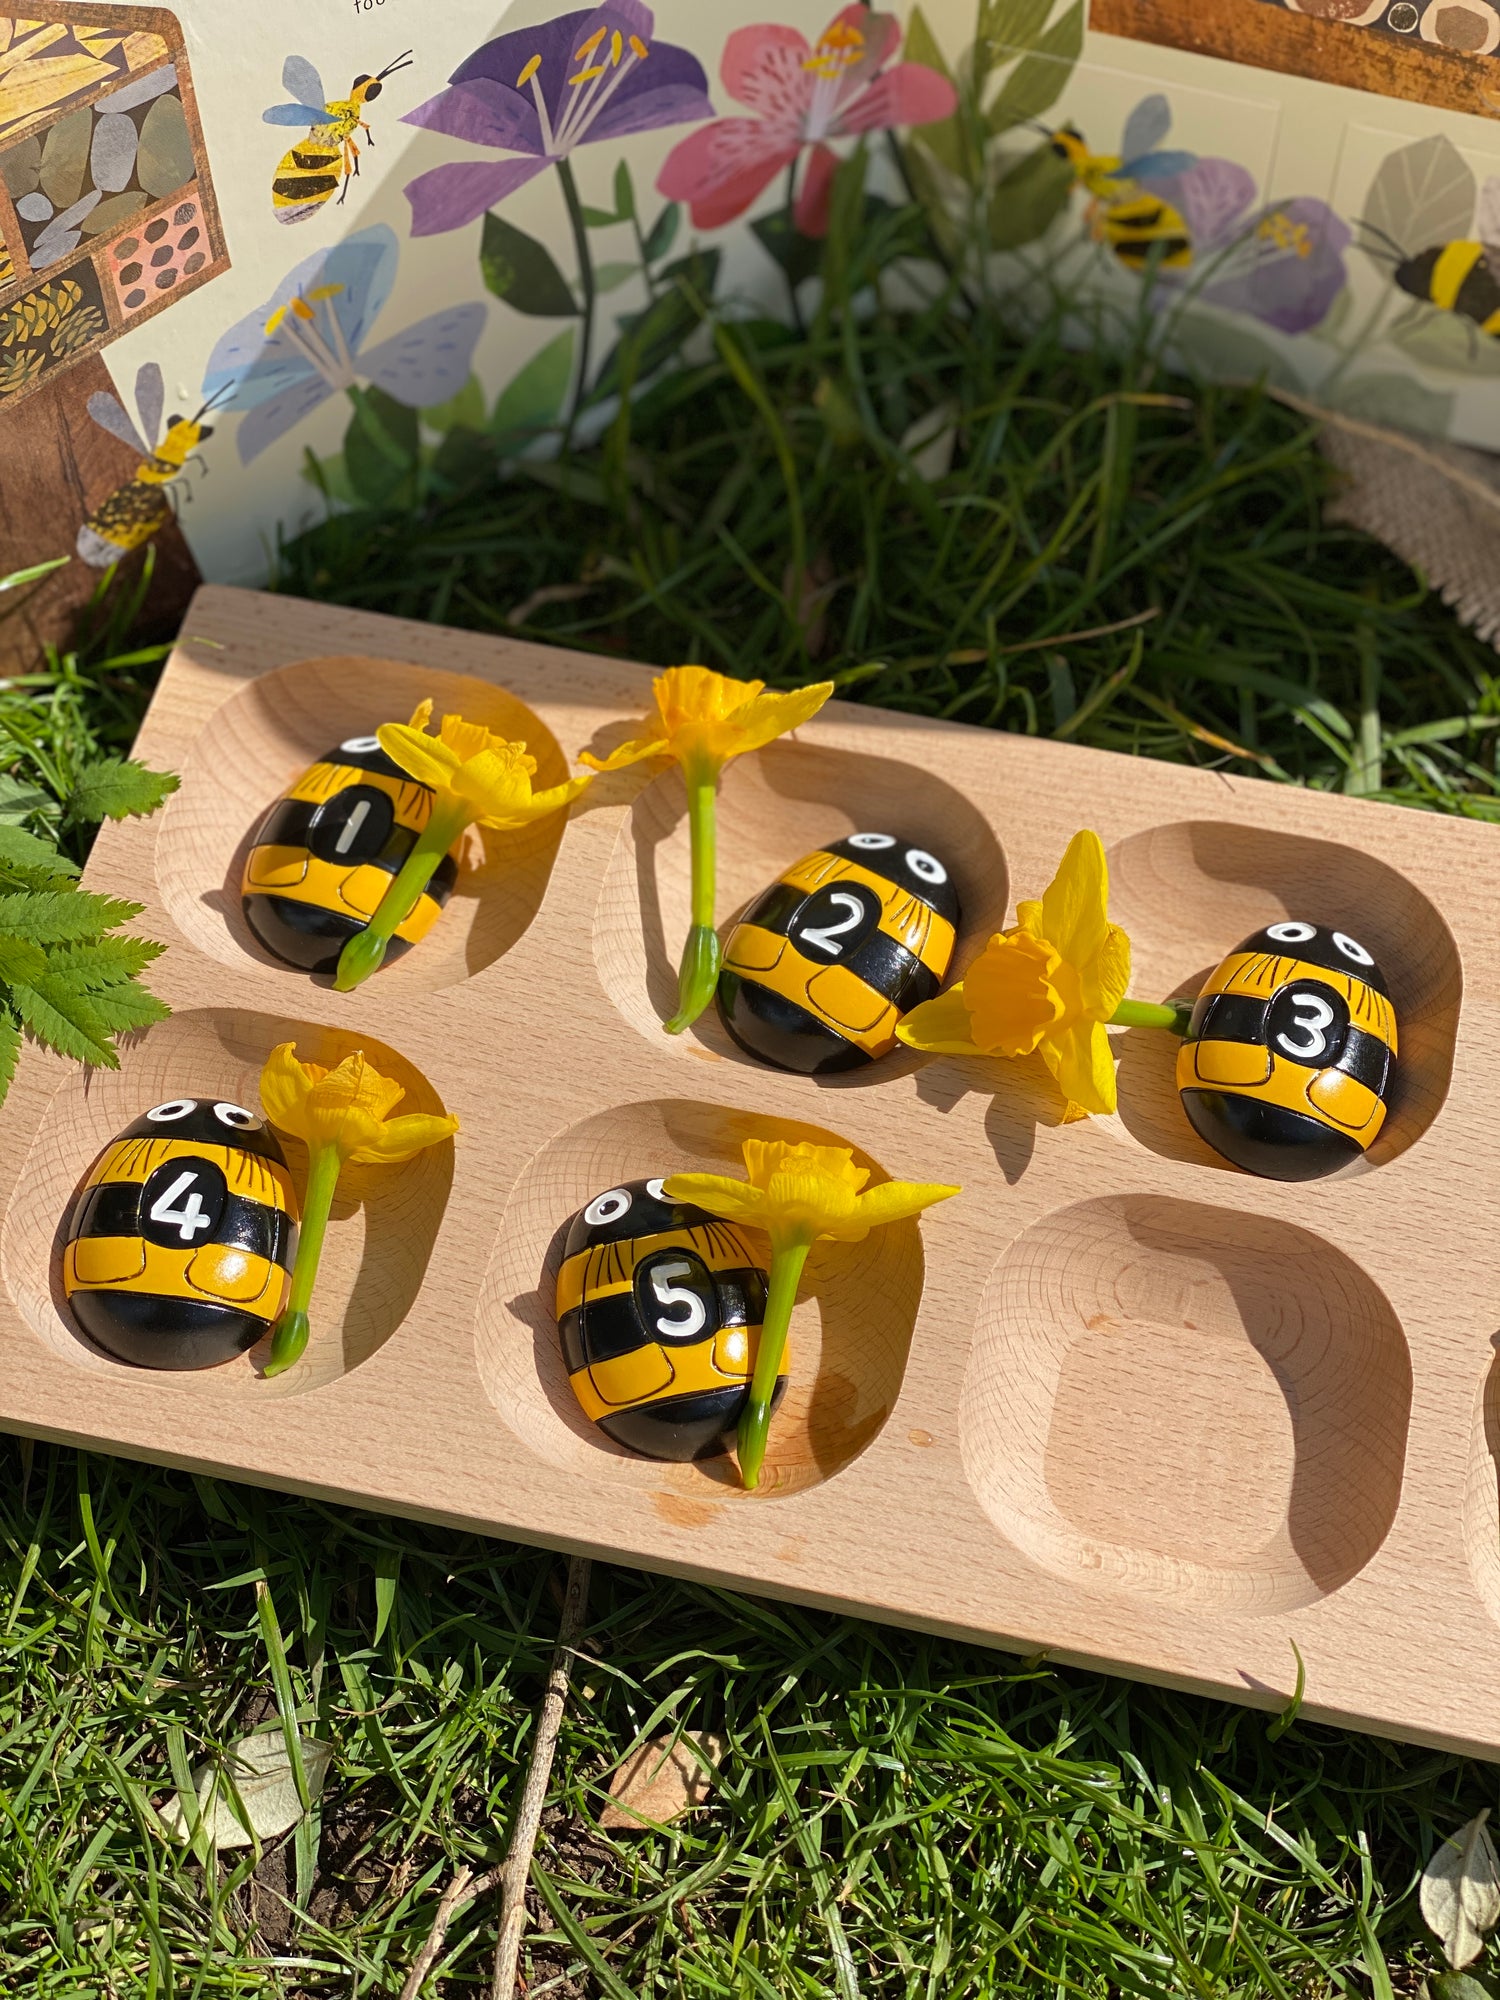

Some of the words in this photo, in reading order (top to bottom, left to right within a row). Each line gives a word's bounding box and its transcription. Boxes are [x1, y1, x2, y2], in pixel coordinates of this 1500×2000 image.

[335, 800, 371, 854] 1
[800, 893, 865, 956] 2
[1276, 994, 1334, 1058] 3
[150, 1171, 211, 1240] 4
[650, 1262, 706, 1337] 5
